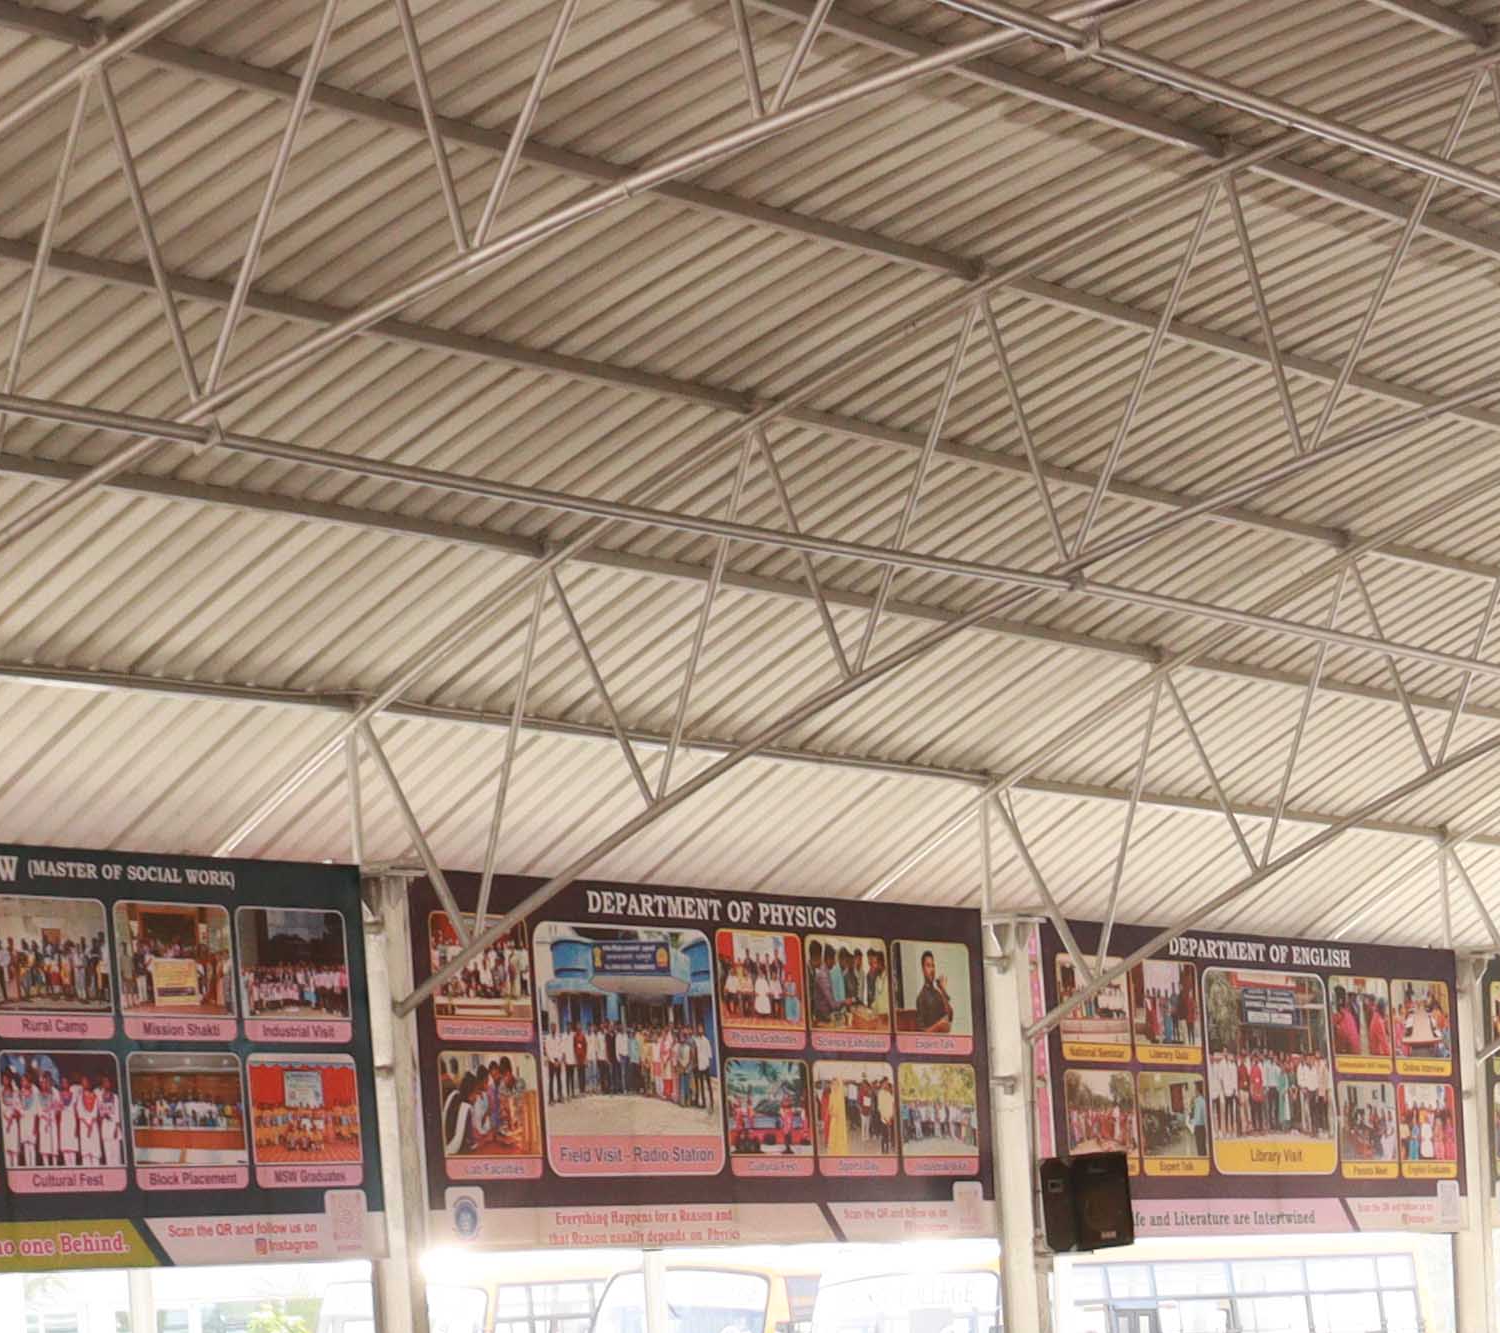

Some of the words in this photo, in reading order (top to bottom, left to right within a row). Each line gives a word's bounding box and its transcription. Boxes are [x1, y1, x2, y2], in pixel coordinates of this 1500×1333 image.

[27, 859, 99, 881] (MASTER
[101, 863, 123, 882] OF
[126, 866, 182, 885] SOCIAL
[185, 869, 237, 892] WORK)
[586, 890, 723, 923] DEPARTMENT
[727, 901, 753, 924] OF
[758, 902, 838, 929] PHYSICS
[1168, 937, 1266, 962] DEPARTMENT
[1269, 943, 1289, 963] OF
[1292, 947, 1352, 969] ENGLISH
[21, 1018, 53, 1033] Rural
[54, 1018, 89, 1035] Camp
[143, 1022, 185, 1037] Mission
[559, 1146, 592, 1163] Field
[594, 1146, 624, 1163] Visit
[633, 1146, 669, 1162] Radio
[671, 1145, 715, 1163] Station
[1251, 1149, 1282, 1165] Library
[1283, 1149, 1304, 1163] Visit
[31, 1173, 78, 1188] Cultural
[79, 1172, 105, 1187] Fest
[149, 1173, 180, 1187] Block
[183, 1171, 238, 1186] Placement
[555, 1210, 609, 1226] Everything
[1150, 1211, 1170, 1226] and
[1174, 1210, 1230, 1226] Literature
[1233, 1212, 1251, 1225] are
[1253, 1209, 1317, 1225] Intertwined
[167, 1225, 196, 1238] Scan
[197, 1224, 214, 1237] the
[216, 1223, 233, 1237] QR
[235, 1222, 254, 1235] and
[256, 1221, 287, 1235] follow
[289, 1223, 303, 1234] us
[304, 1222, 318, 1234] on
[20, 1239, 56, 1256] one
[59, 1232, 131, 1256] Behind.
[268, 1238, 319, 1253] Instagram
